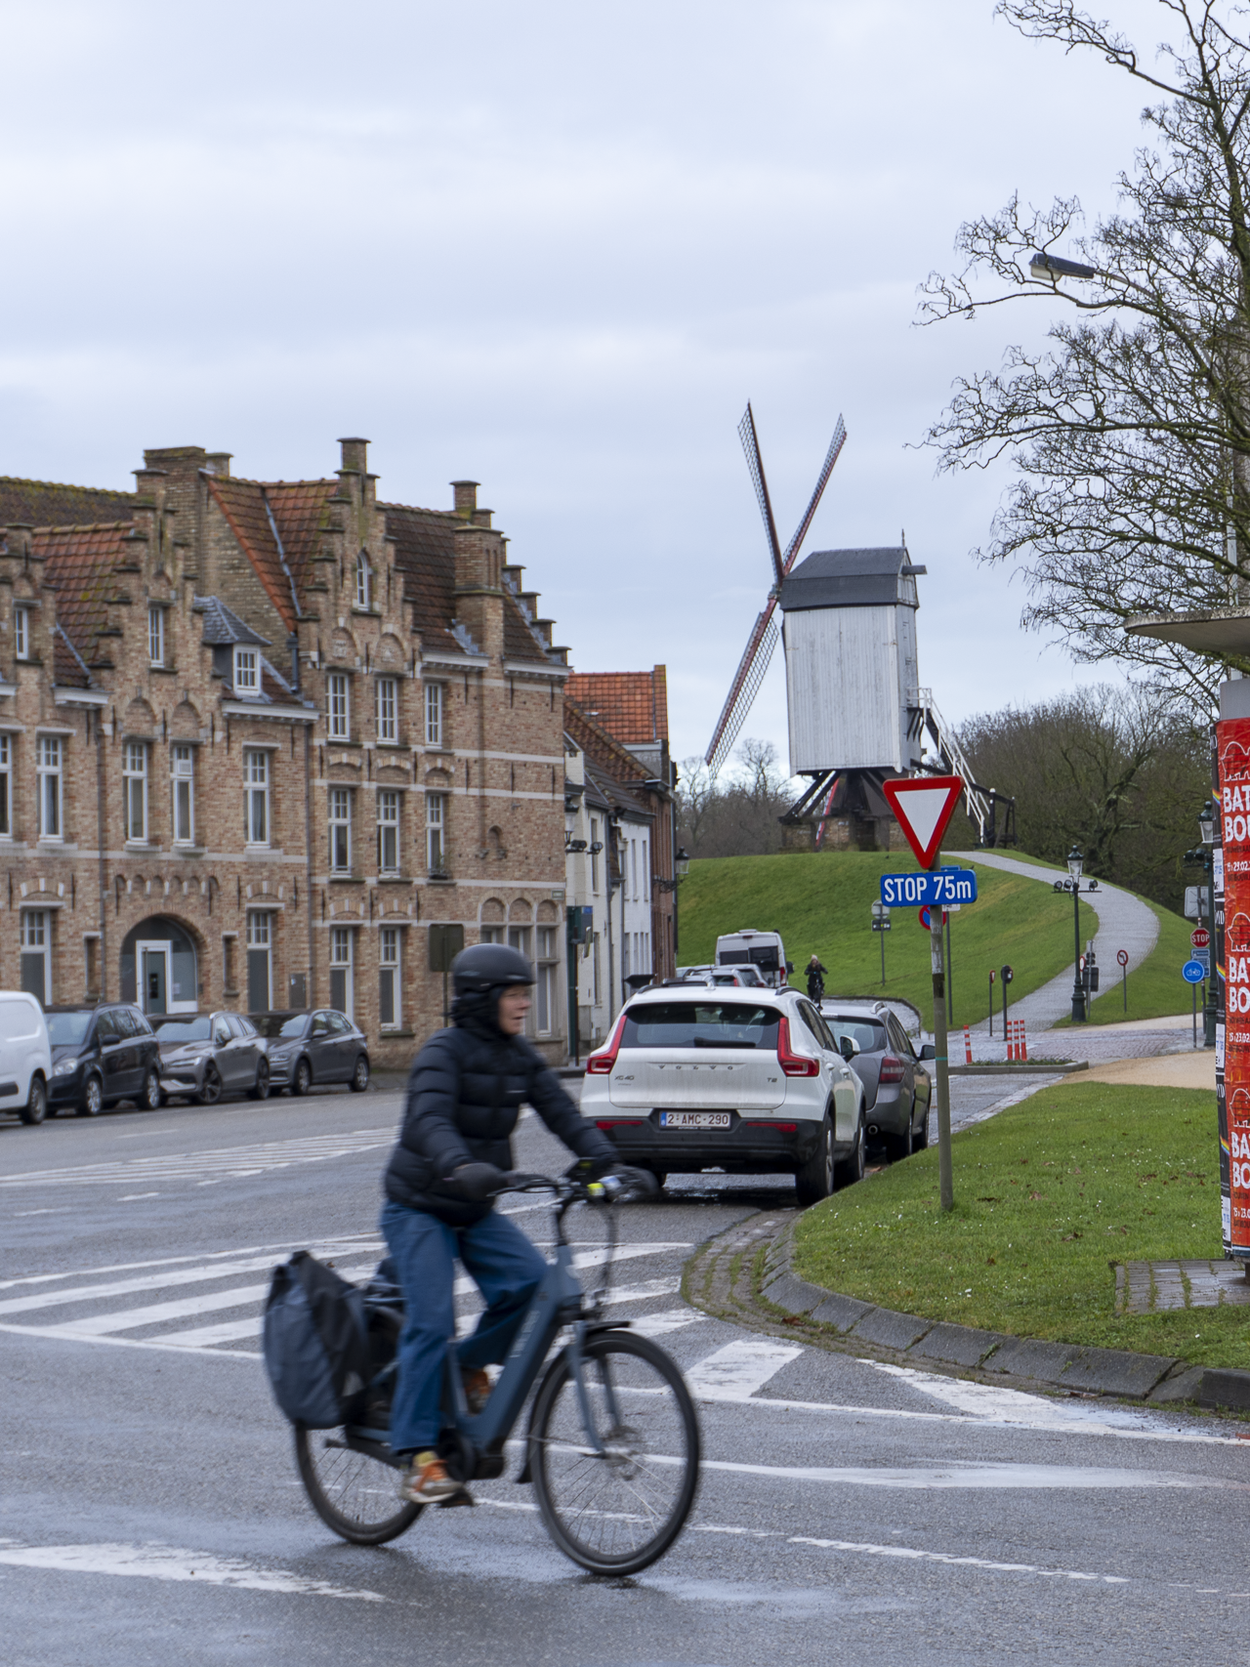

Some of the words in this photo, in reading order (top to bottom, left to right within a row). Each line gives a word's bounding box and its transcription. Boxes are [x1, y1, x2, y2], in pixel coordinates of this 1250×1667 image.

[884, 877, 927, 902] STOP
[933, 876, 971, 900] 75m
[1192, 934, 1209, 942] STOP
